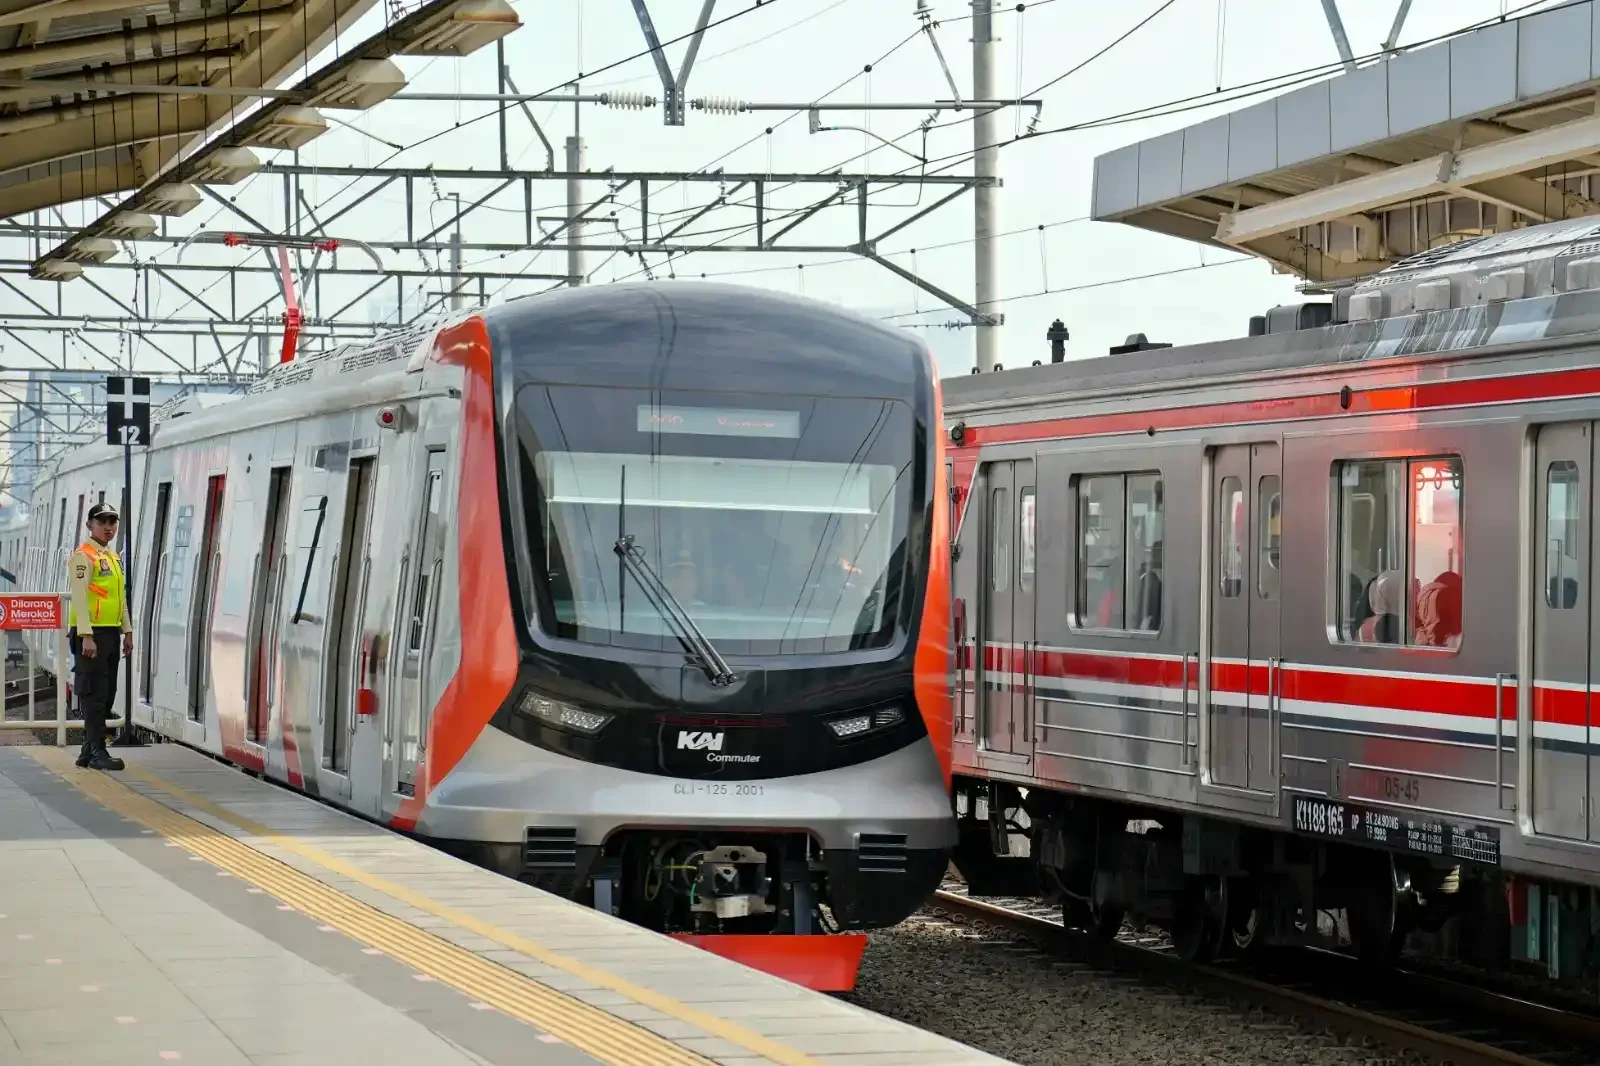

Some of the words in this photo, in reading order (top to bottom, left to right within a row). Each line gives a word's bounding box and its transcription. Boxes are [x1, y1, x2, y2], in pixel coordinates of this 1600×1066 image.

[118, 425, 140, 445] 12
[11, 599, 53, 610] Dilarang
[11, 609, 56, 618] Merokok
[677, 730, 724, 751] KAI
[706, 752, 761, 763] Commuter
[1385, 776, 1419, 802] 05-45
